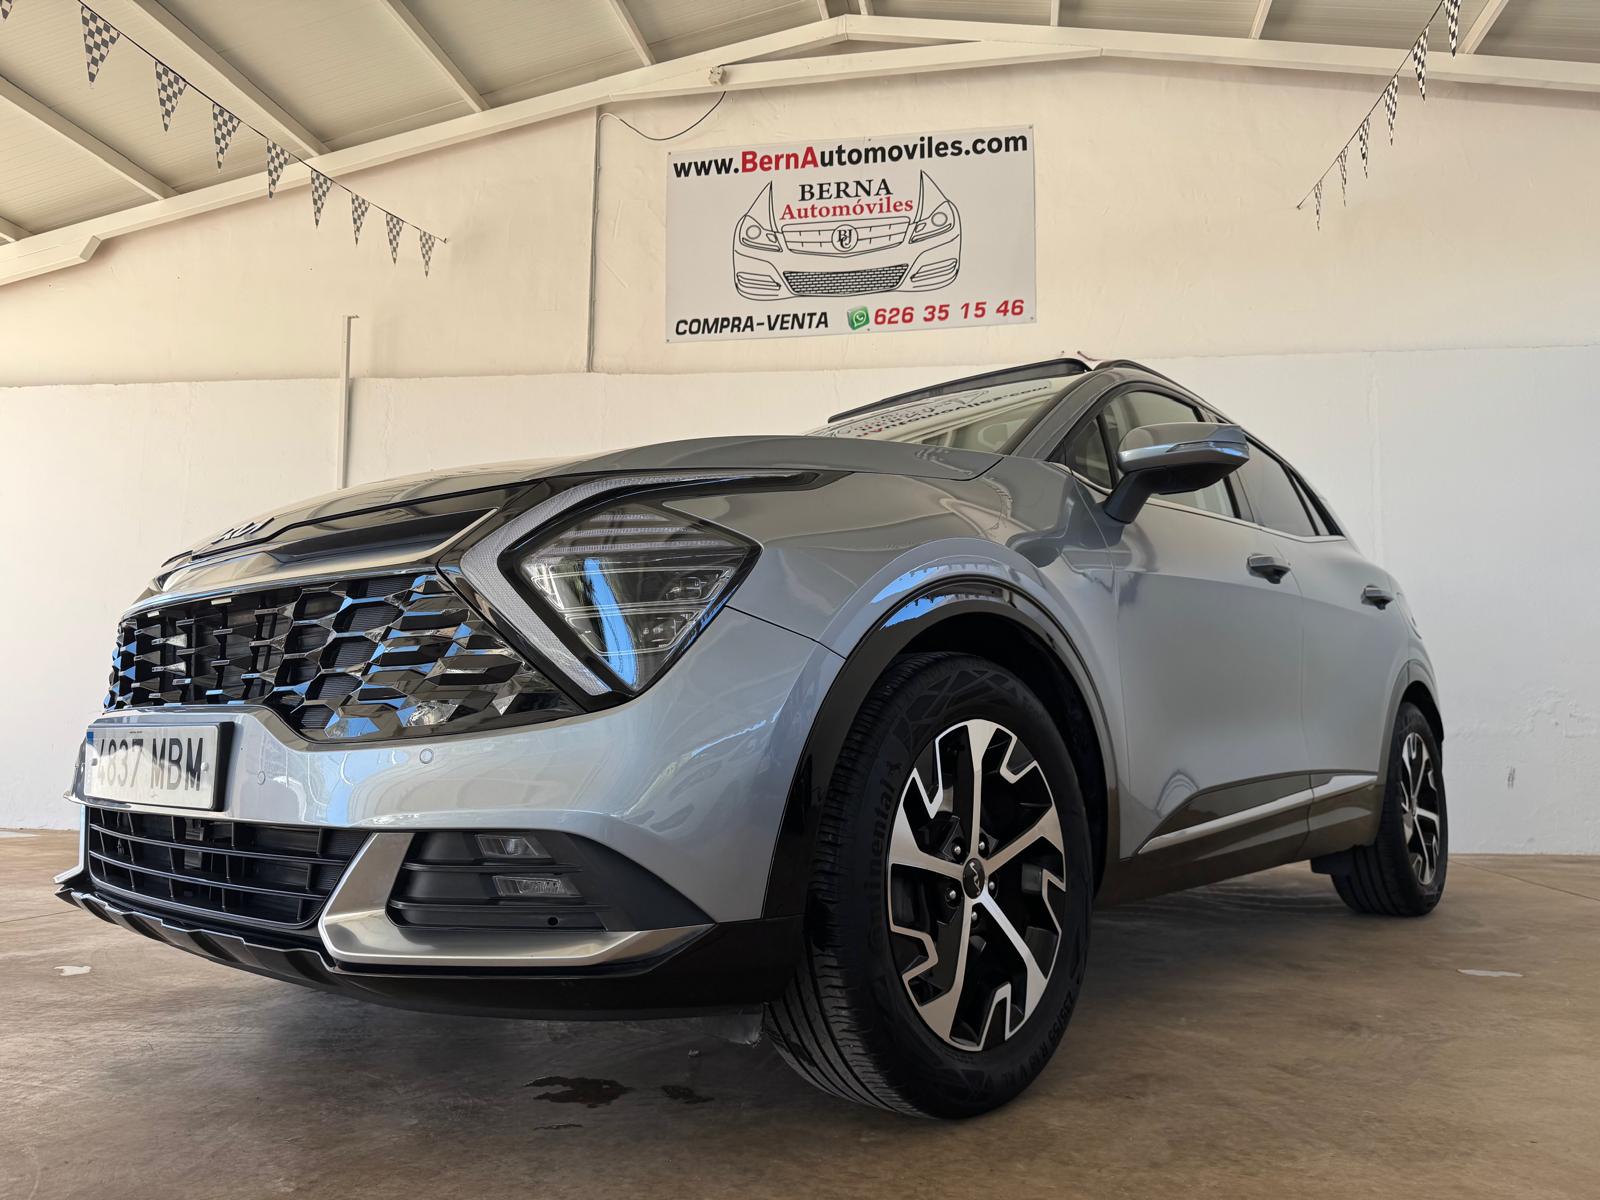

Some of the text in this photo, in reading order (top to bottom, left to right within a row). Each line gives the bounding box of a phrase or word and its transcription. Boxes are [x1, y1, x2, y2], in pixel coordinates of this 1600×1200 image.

[673, 134, 1027, 178] www.BernAutomoviles.com
[798, 178, 894, 202] BERNA
[779, 196, 914, 220] Automóviles
[675, 311, 829, 336] COMPRA-VENTA
[874, 299, 1025, 326] 626 35 15 46
[150, 737, 203, 791] MBM
